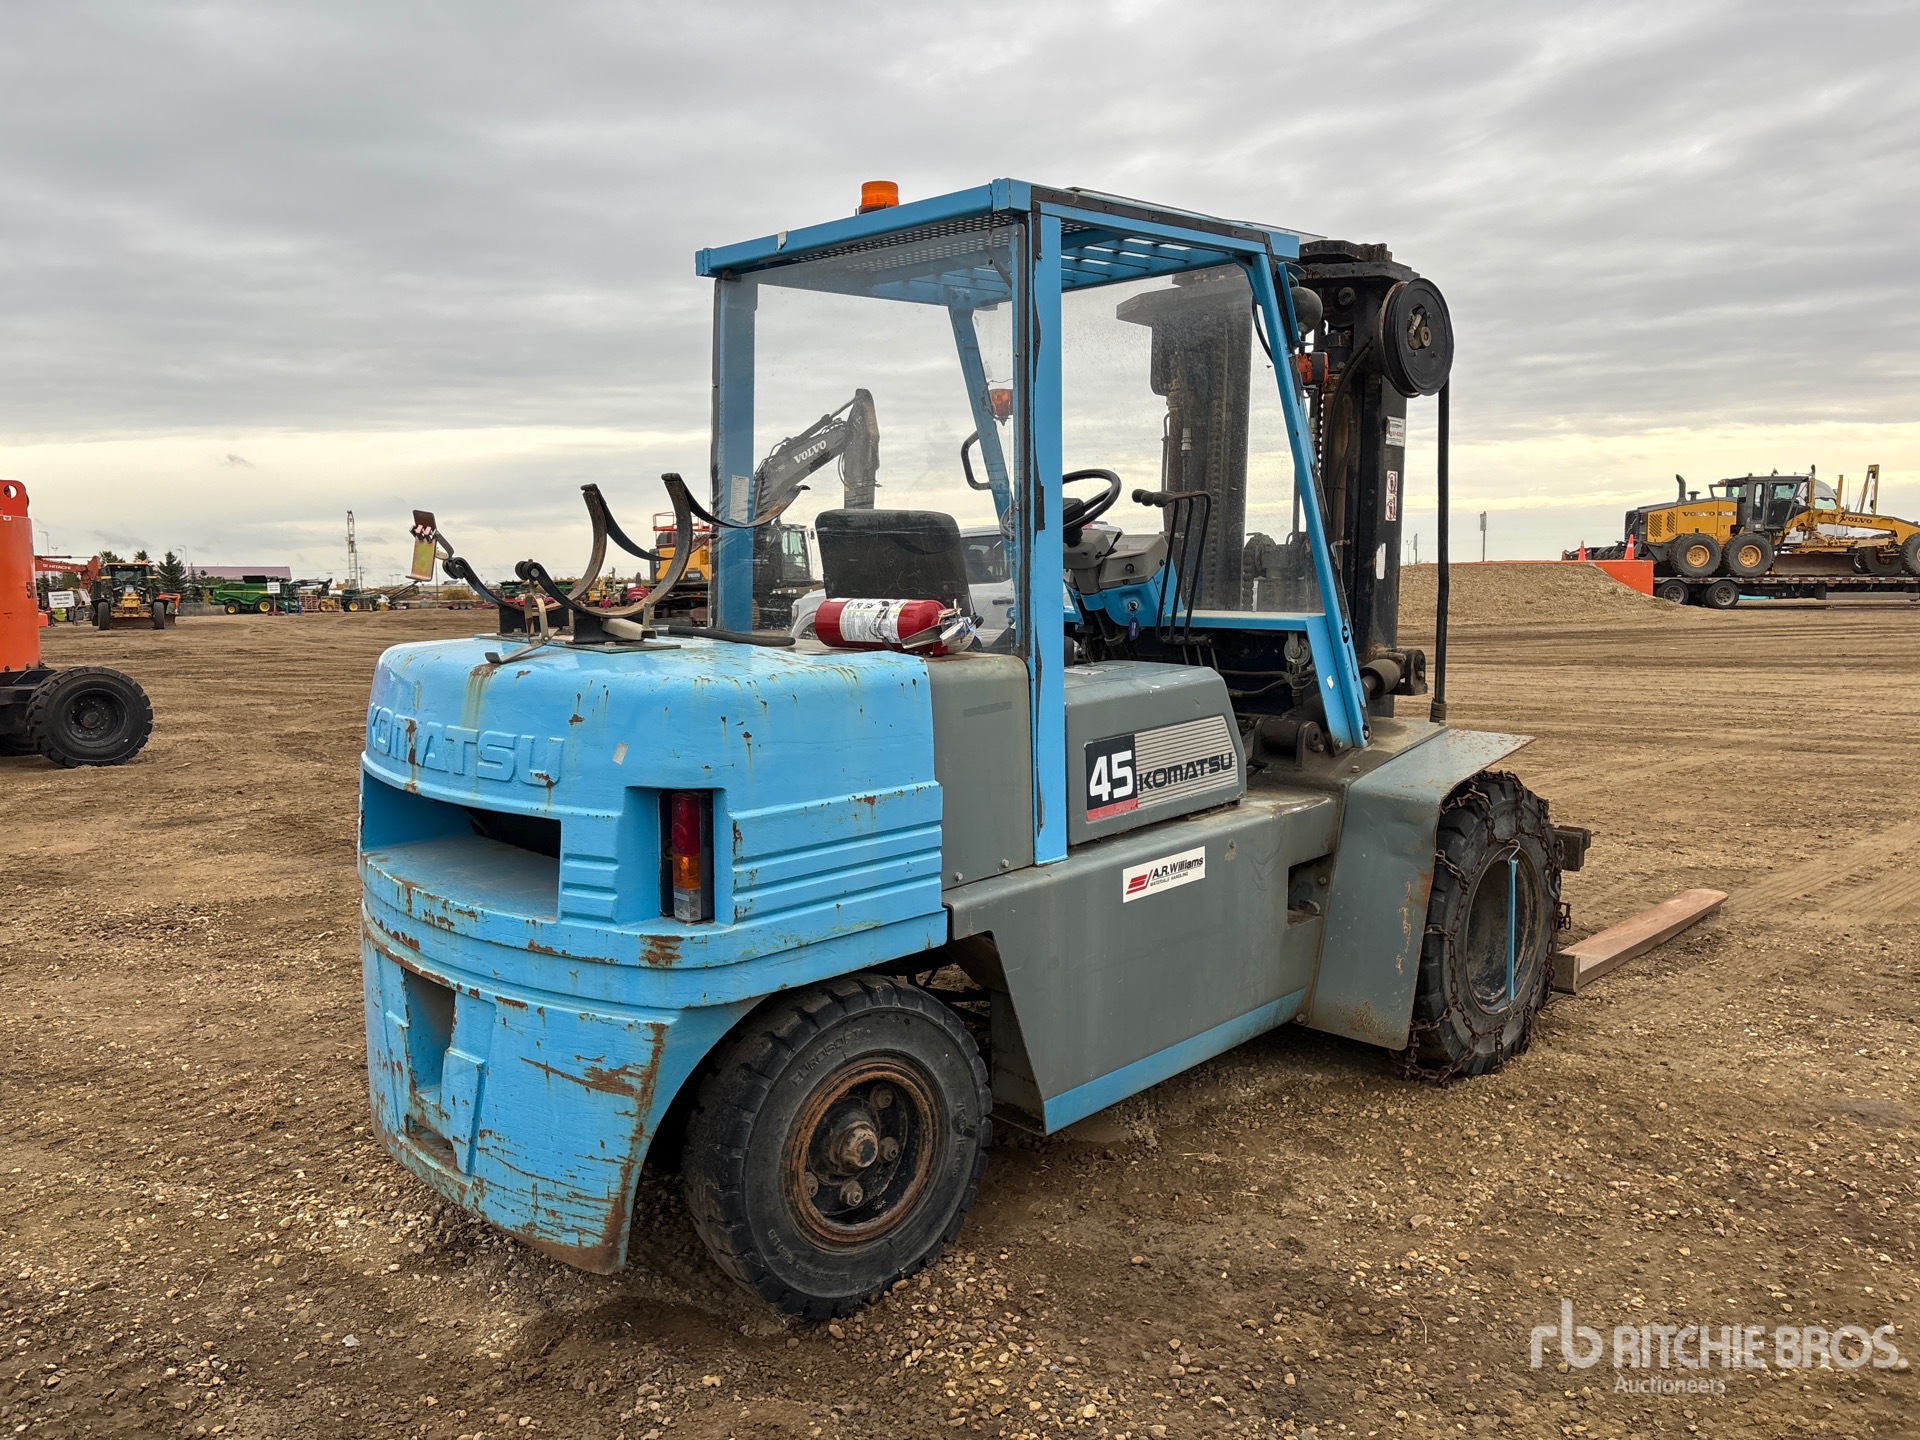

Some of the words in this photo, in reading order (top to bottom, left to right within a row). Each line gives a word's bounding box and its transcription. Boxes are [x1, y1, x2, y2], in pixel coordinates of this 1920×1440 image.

[794, 440, 826, 463] VOLVO
[1841, 516, 1872, 524] VOLVO
[369, 702, 565, 787] KOMATSU
[1089, 750, 1133, 801] 45
[1139, 753, 1233, 791] KOMATSU
[1150, 878, 1170, 887] MATERIALS
[1171, 872, 1188, 880] HANDLING
